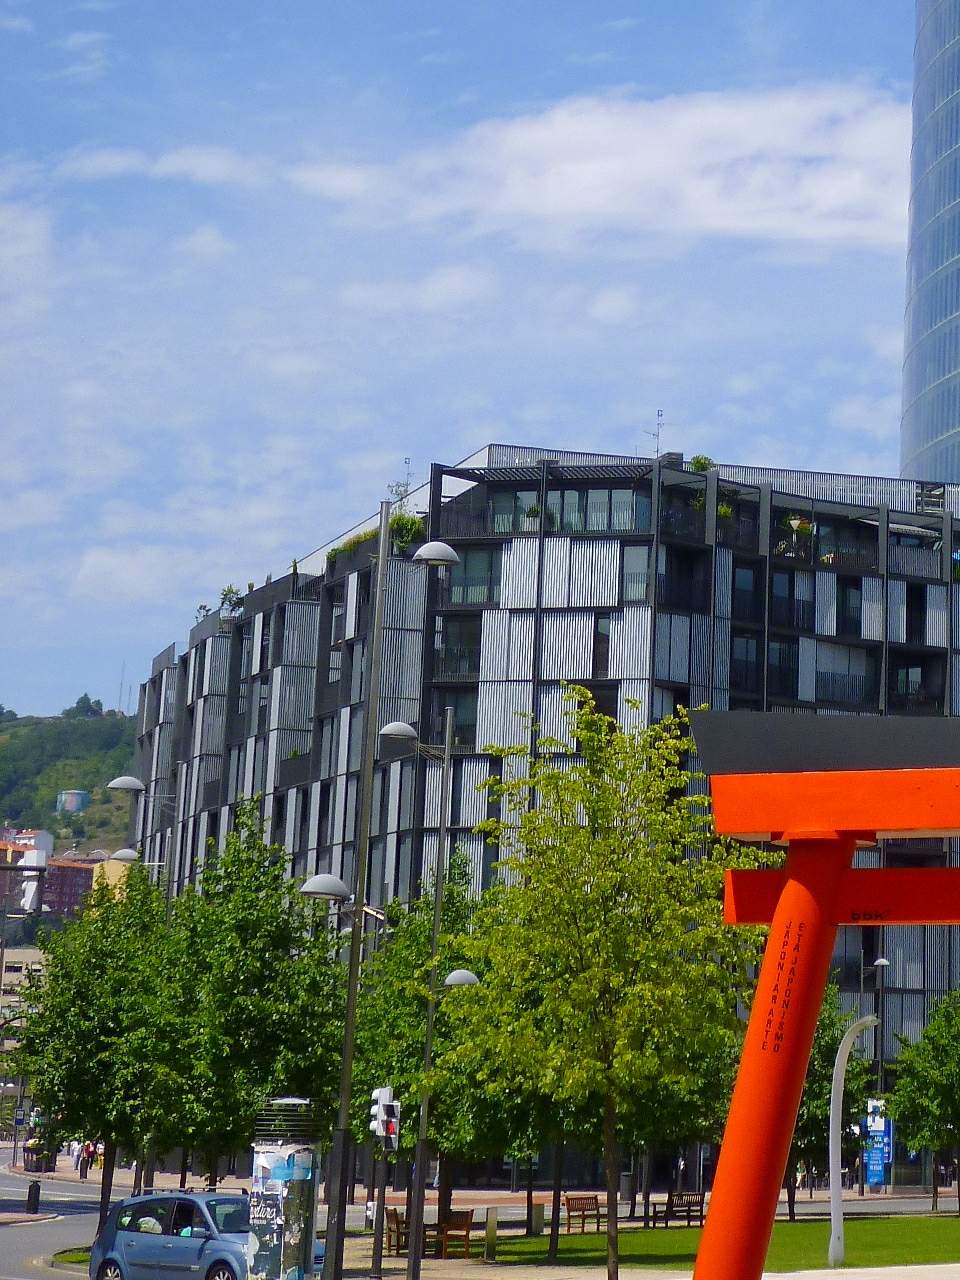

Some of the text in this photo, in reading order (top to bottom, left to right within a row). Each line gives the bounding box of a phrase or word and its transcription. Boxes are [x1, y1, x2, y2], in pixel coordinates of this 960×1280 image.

[762, 920, 793, 1051] JAPONIAR ARTE
[773, 922, 806, 1053] ETA JAPONISMO
